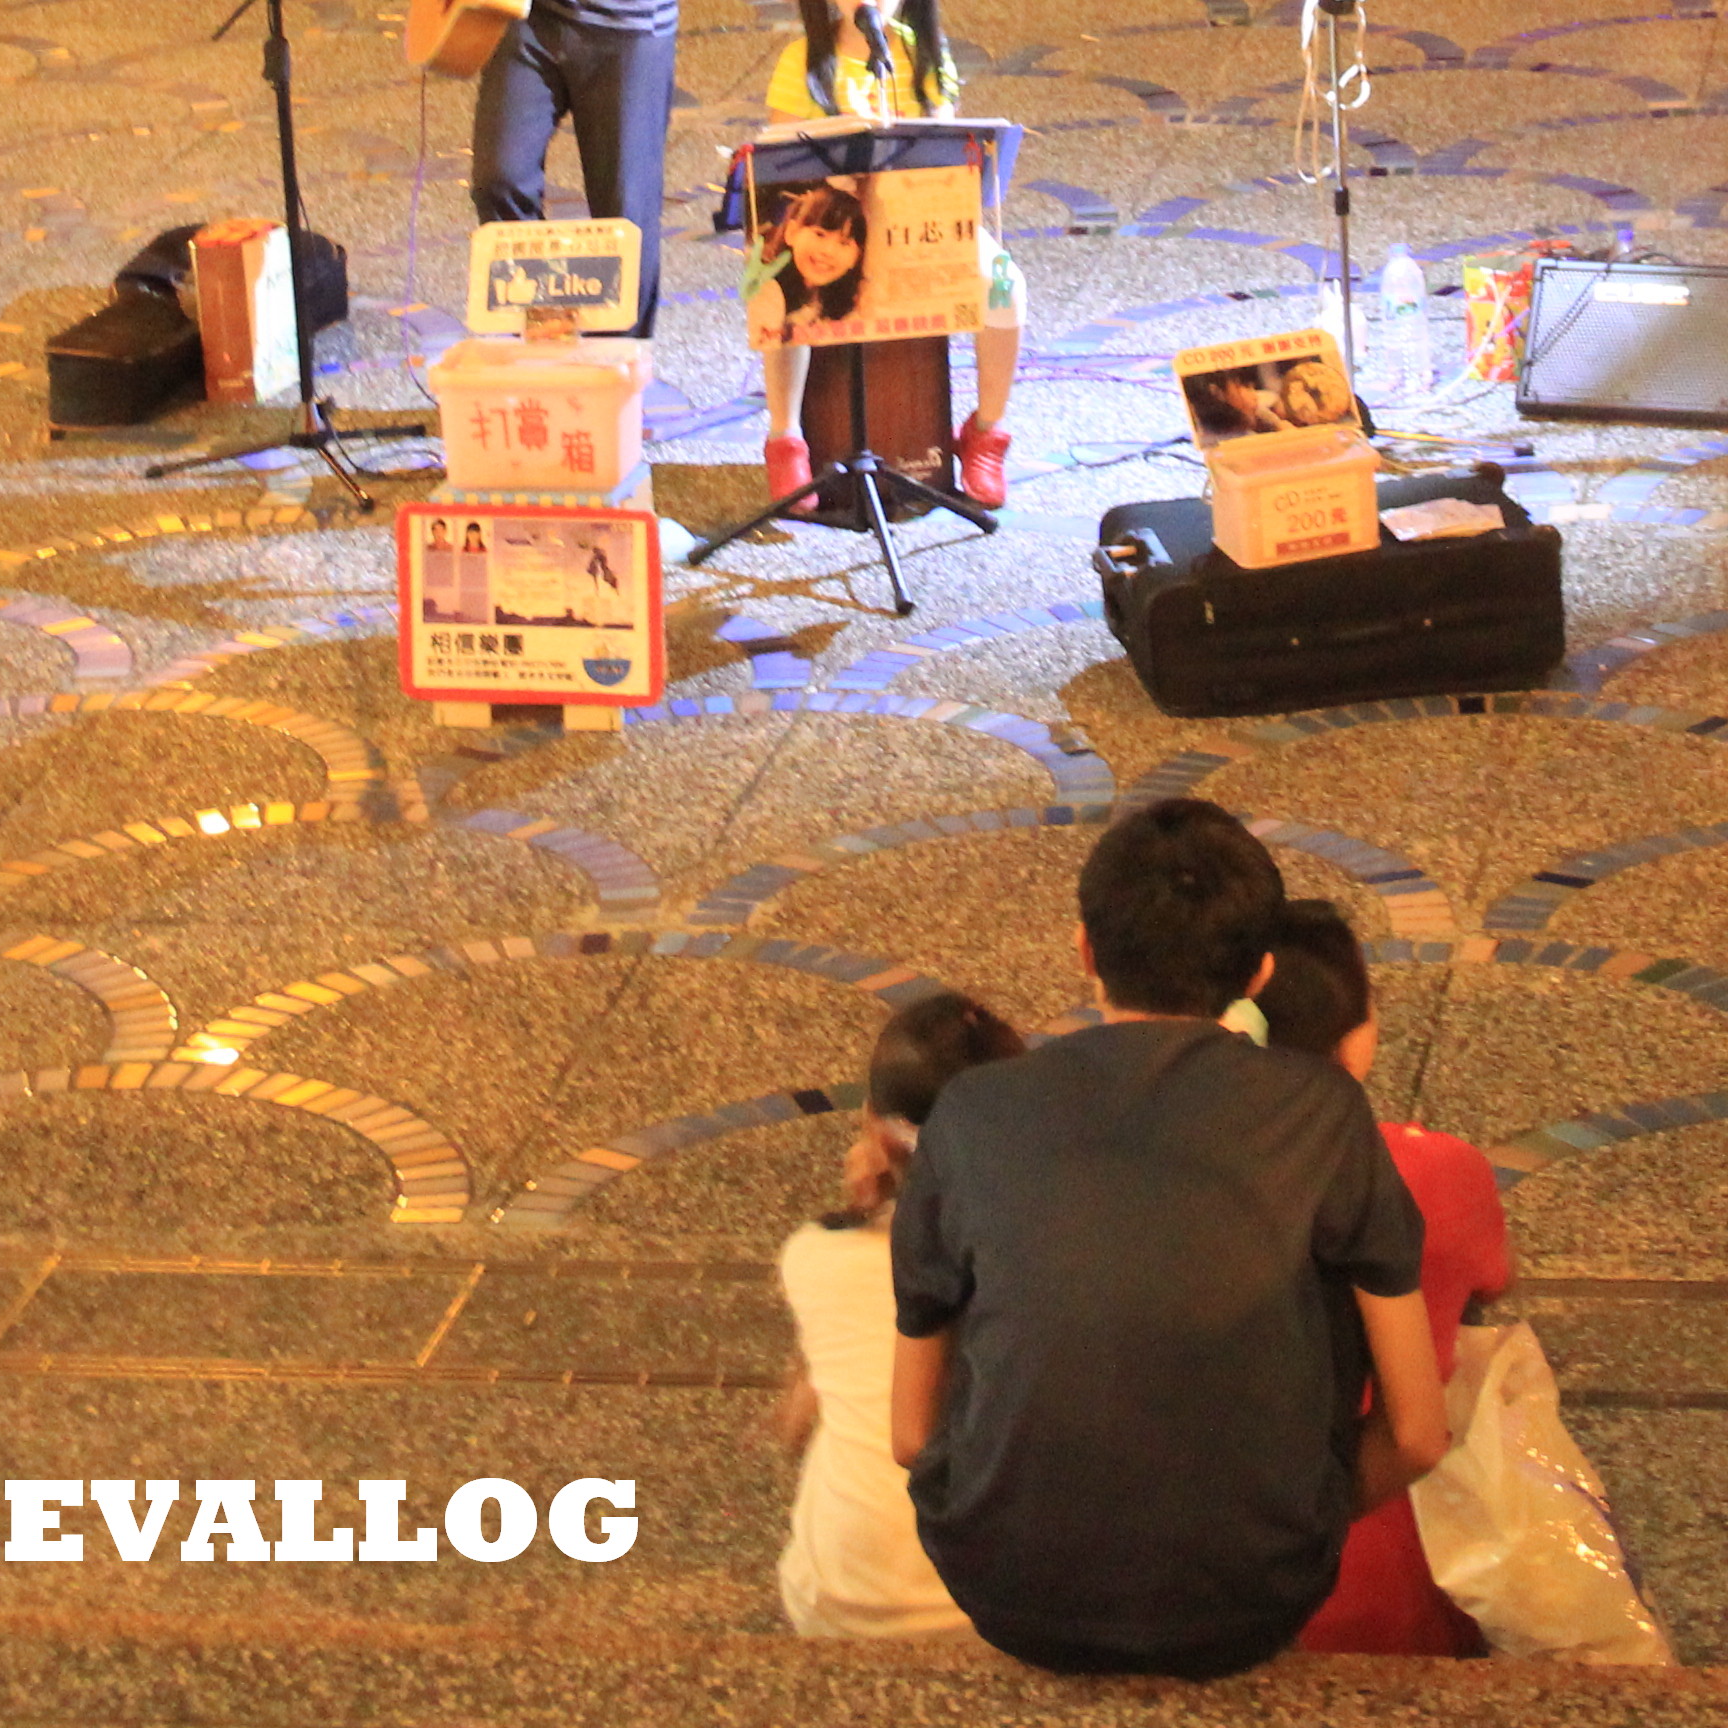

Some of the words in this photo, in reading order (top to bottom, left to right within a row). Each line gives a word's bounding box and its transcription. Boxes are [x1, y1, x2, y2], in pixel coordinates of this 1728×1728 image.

[547, 272, 603, 297] Like
[1274, 490, 1300, 513] CD
[1287, 509, 1326, 533] 200
